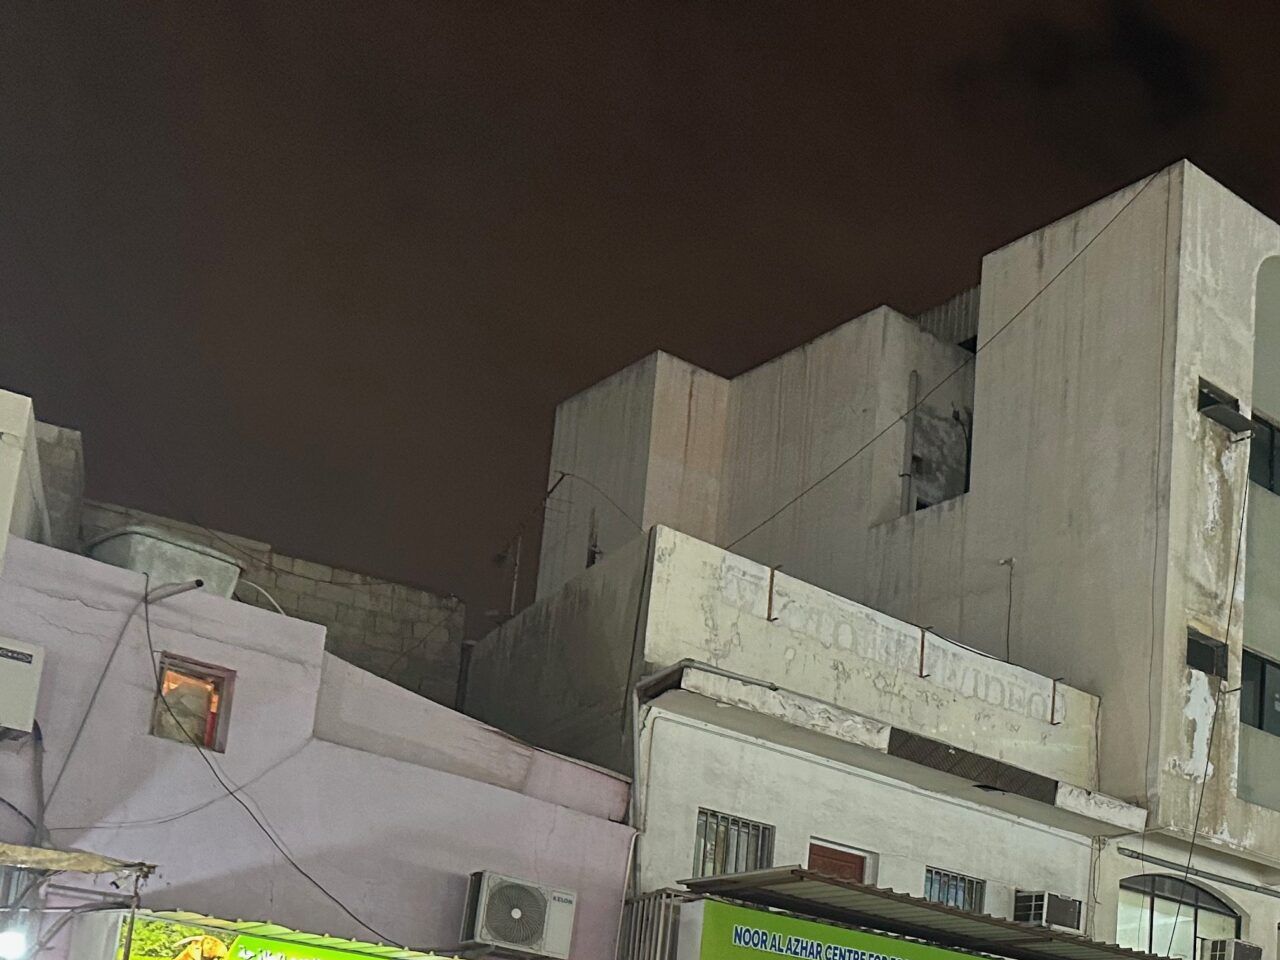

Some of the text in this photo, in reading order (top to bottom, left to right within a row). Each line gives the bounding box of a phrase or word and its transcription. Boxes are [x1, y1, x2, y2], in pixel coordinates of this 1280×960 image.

[733, 925, 768, 950] NOOR
[770, 933, 785, 952] AL
[786, 936, 823, 960] AZHAR
